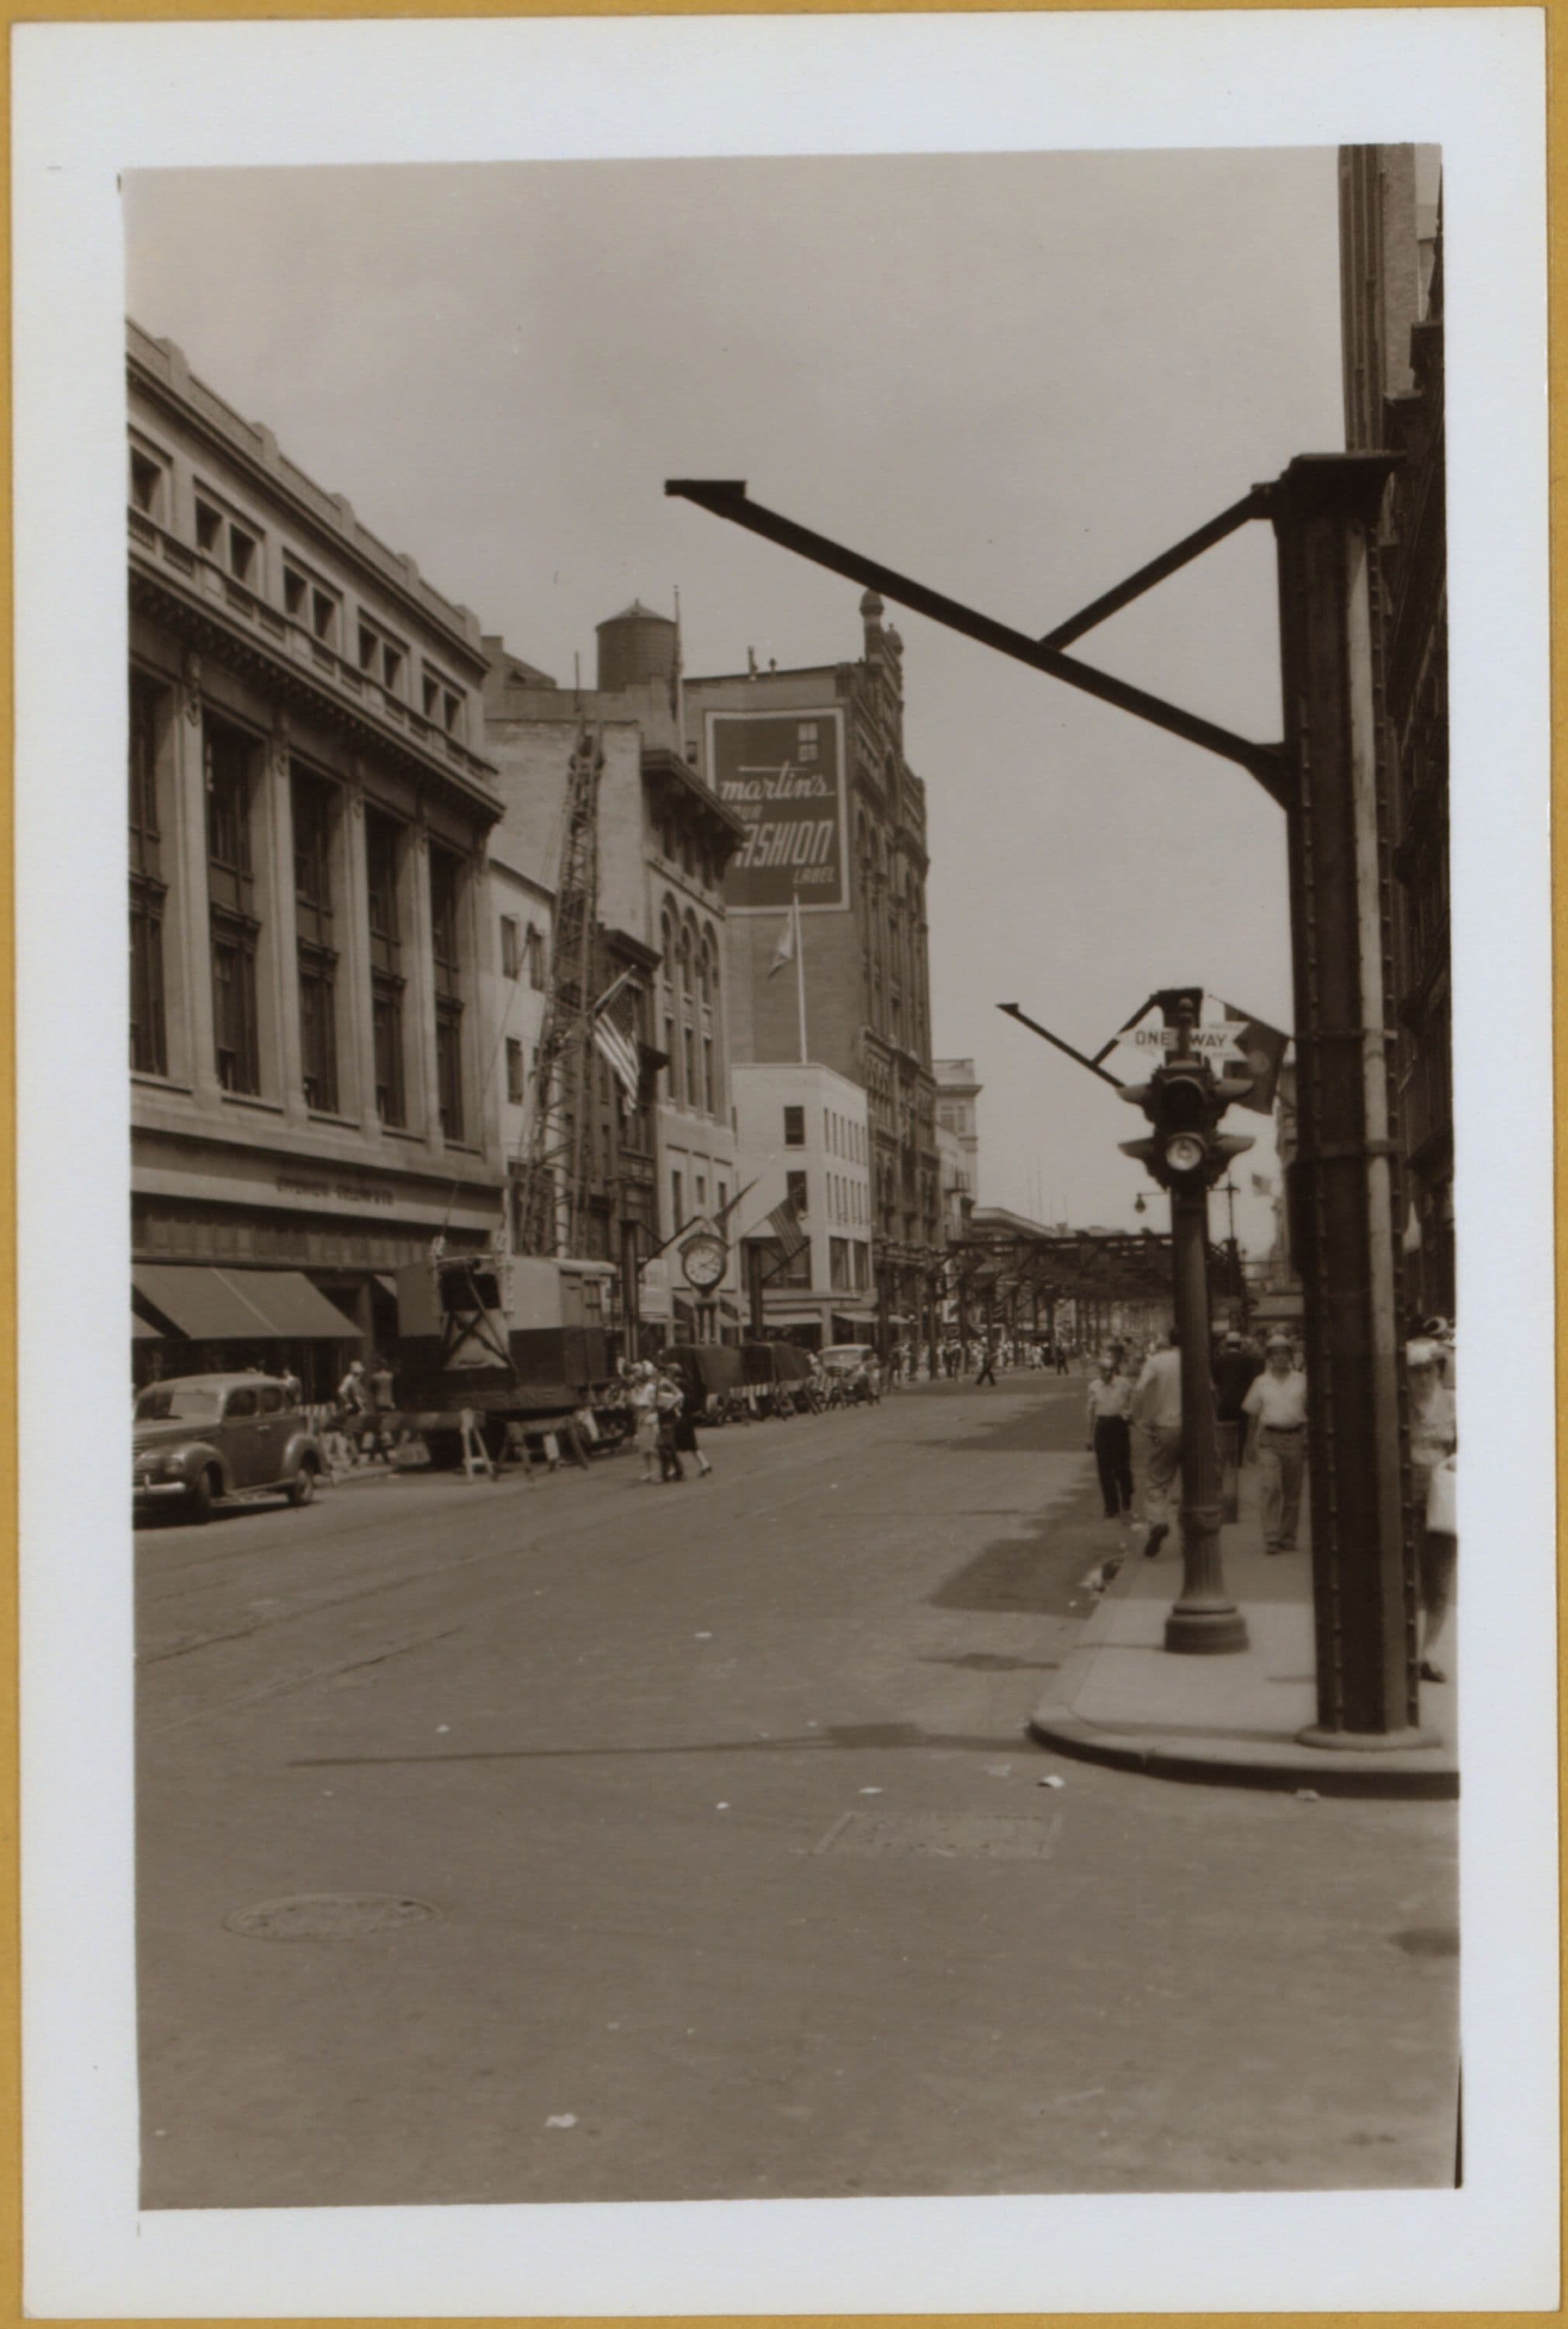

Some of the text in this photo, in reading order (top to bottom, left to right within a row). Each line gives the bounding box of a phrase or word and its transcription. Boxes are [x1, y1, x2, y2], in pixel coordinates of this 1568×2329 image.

[721, 761, 836, 800] martin's
[735, 820, 833, 868] ASHION
[1135, 1031, 1227, 1048] ONE WAY
